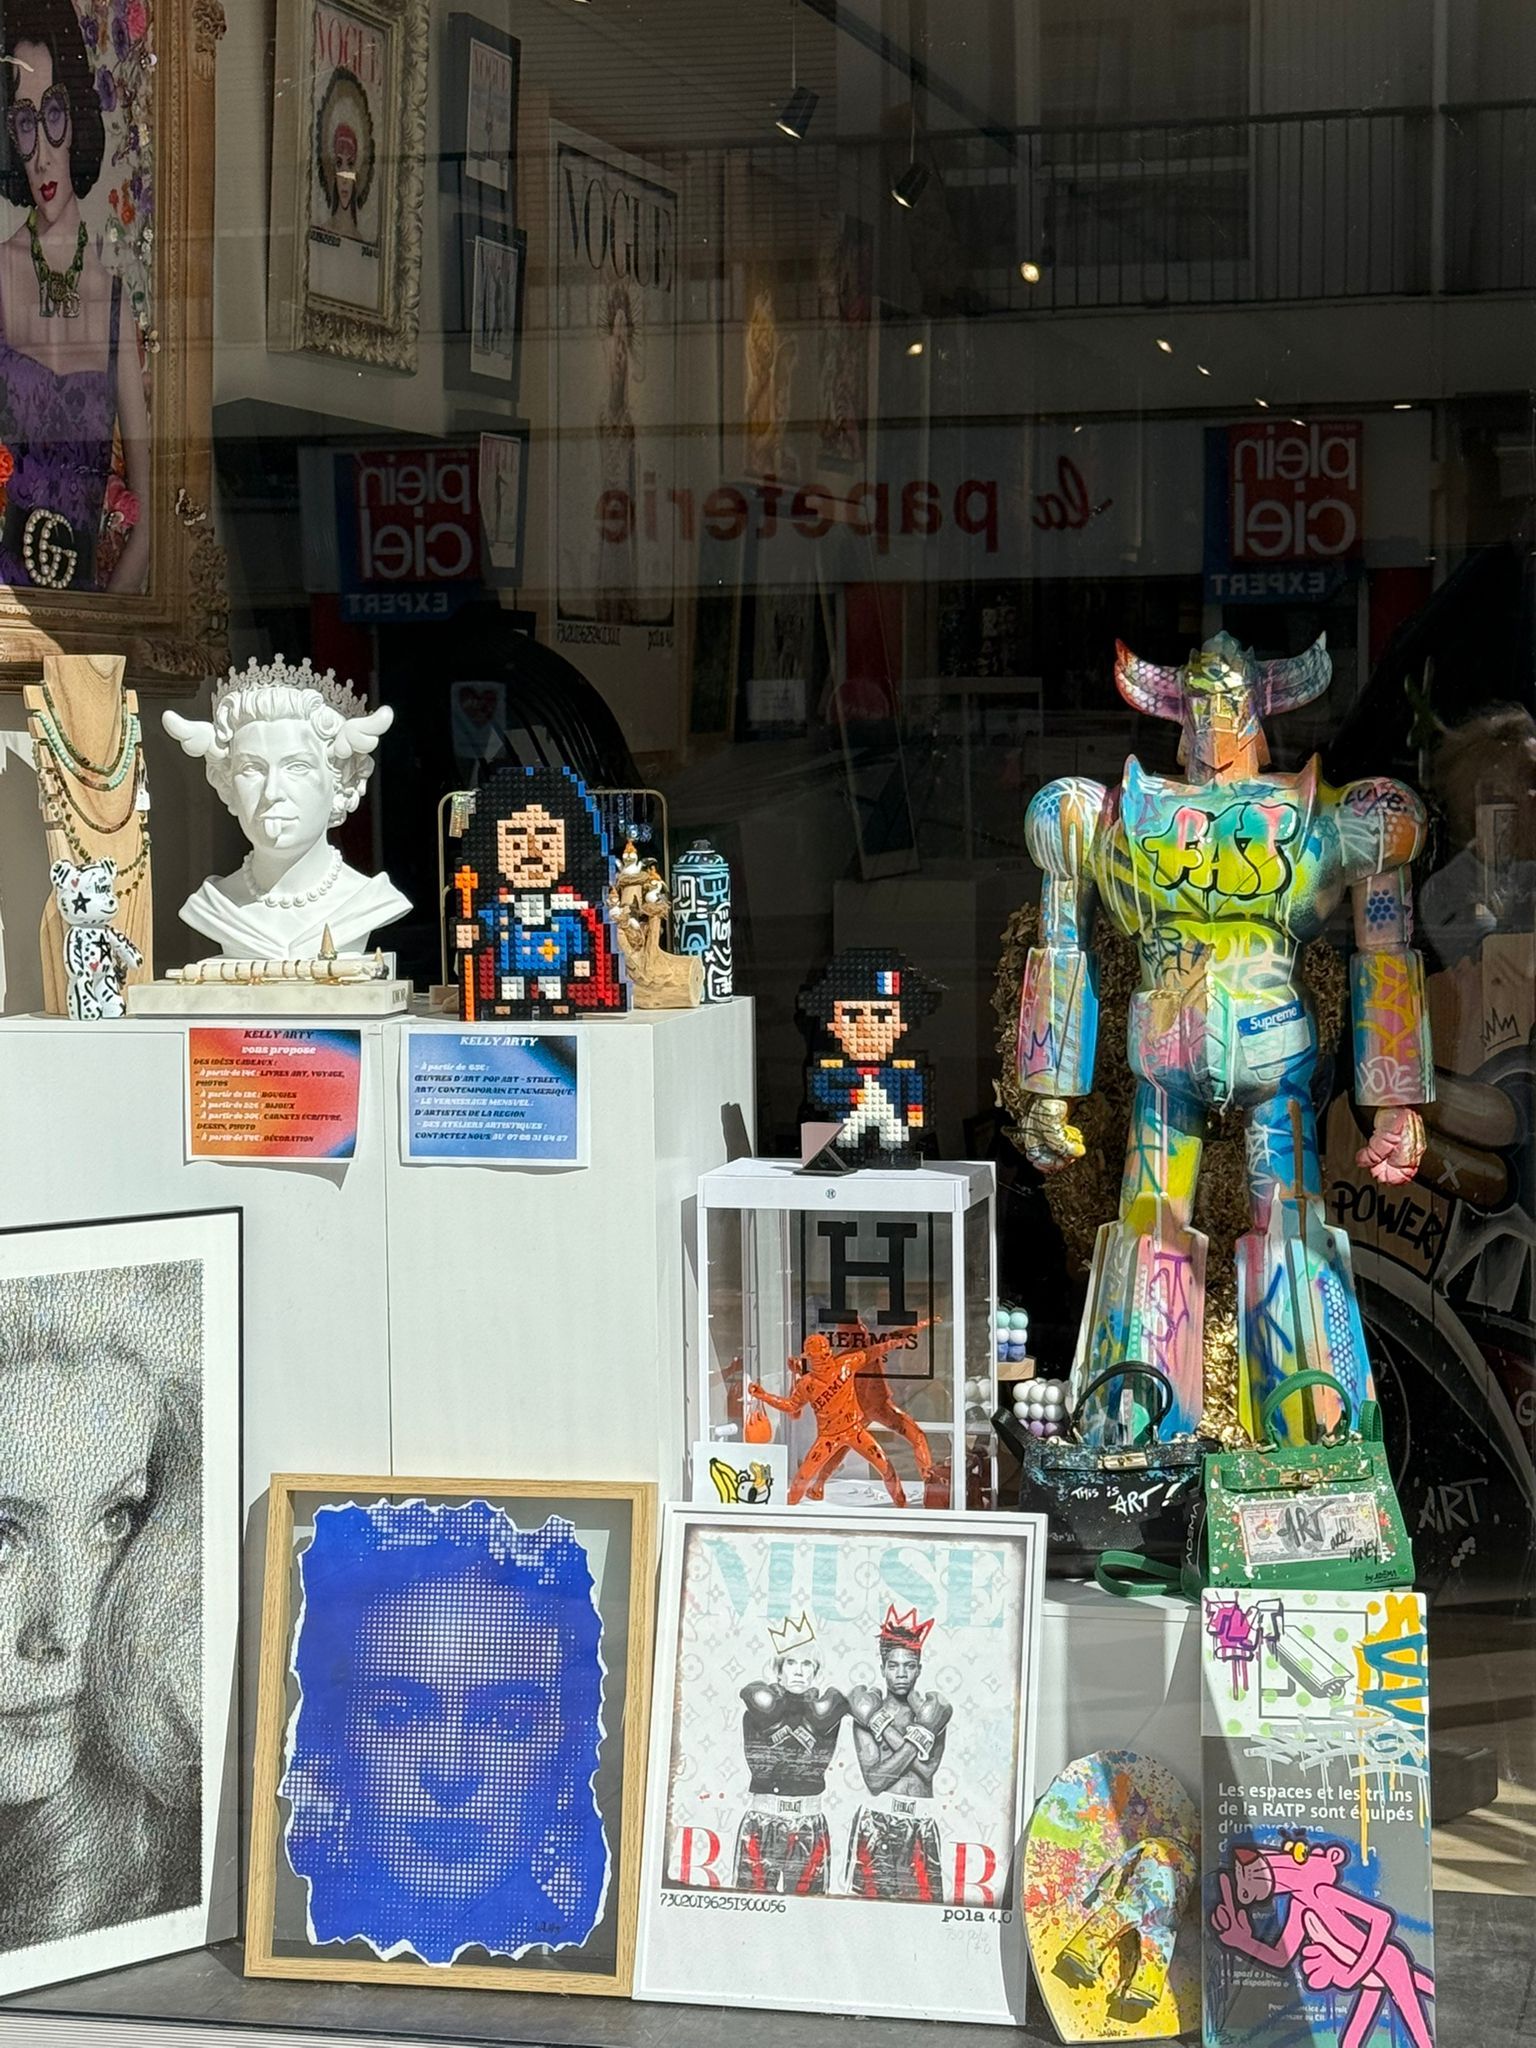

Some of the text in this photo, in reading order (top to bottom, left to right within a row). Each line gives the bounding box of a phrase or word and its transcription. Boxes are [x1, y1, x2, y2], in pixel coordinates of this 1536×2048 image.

[563, 166, 672, 293] VOGUE
[1249, 1007, 1297, 1030] Supreme
[243, 1030, 314, 1039] KELLY ARTY
[460, 1036, 539, 1046] KELLY ARTY
[241, 1045, 317, 1056] vous propose
[482, 1075, 500, 1083] POP
[526, 1075, 562, 1084] STREET
[438, 1086, 507, 1095] CONTEMPORAIN
[467, 1132, 491, 1140] NOUS
[1331, 1182, 1443, 1260] POWER
[817, 1221, 918, 1325] H
[1418, 1477, 1490, 1534] ART
[1277, 1499, 1336, 1549] ART
[700, 1537, 1006, 1628] MUSE
[1218, 1782, 1413, 1802] Les espaces et les trins
[1218, 1800, 1238, 1816] de
[1243, 1801, 1258, 1817] la
[1262, 1802, 1306, 1818] RATP
[1310, 1805, 1347, 1820] sont
[941, 1909, 1013, 1924] pola 4.0
